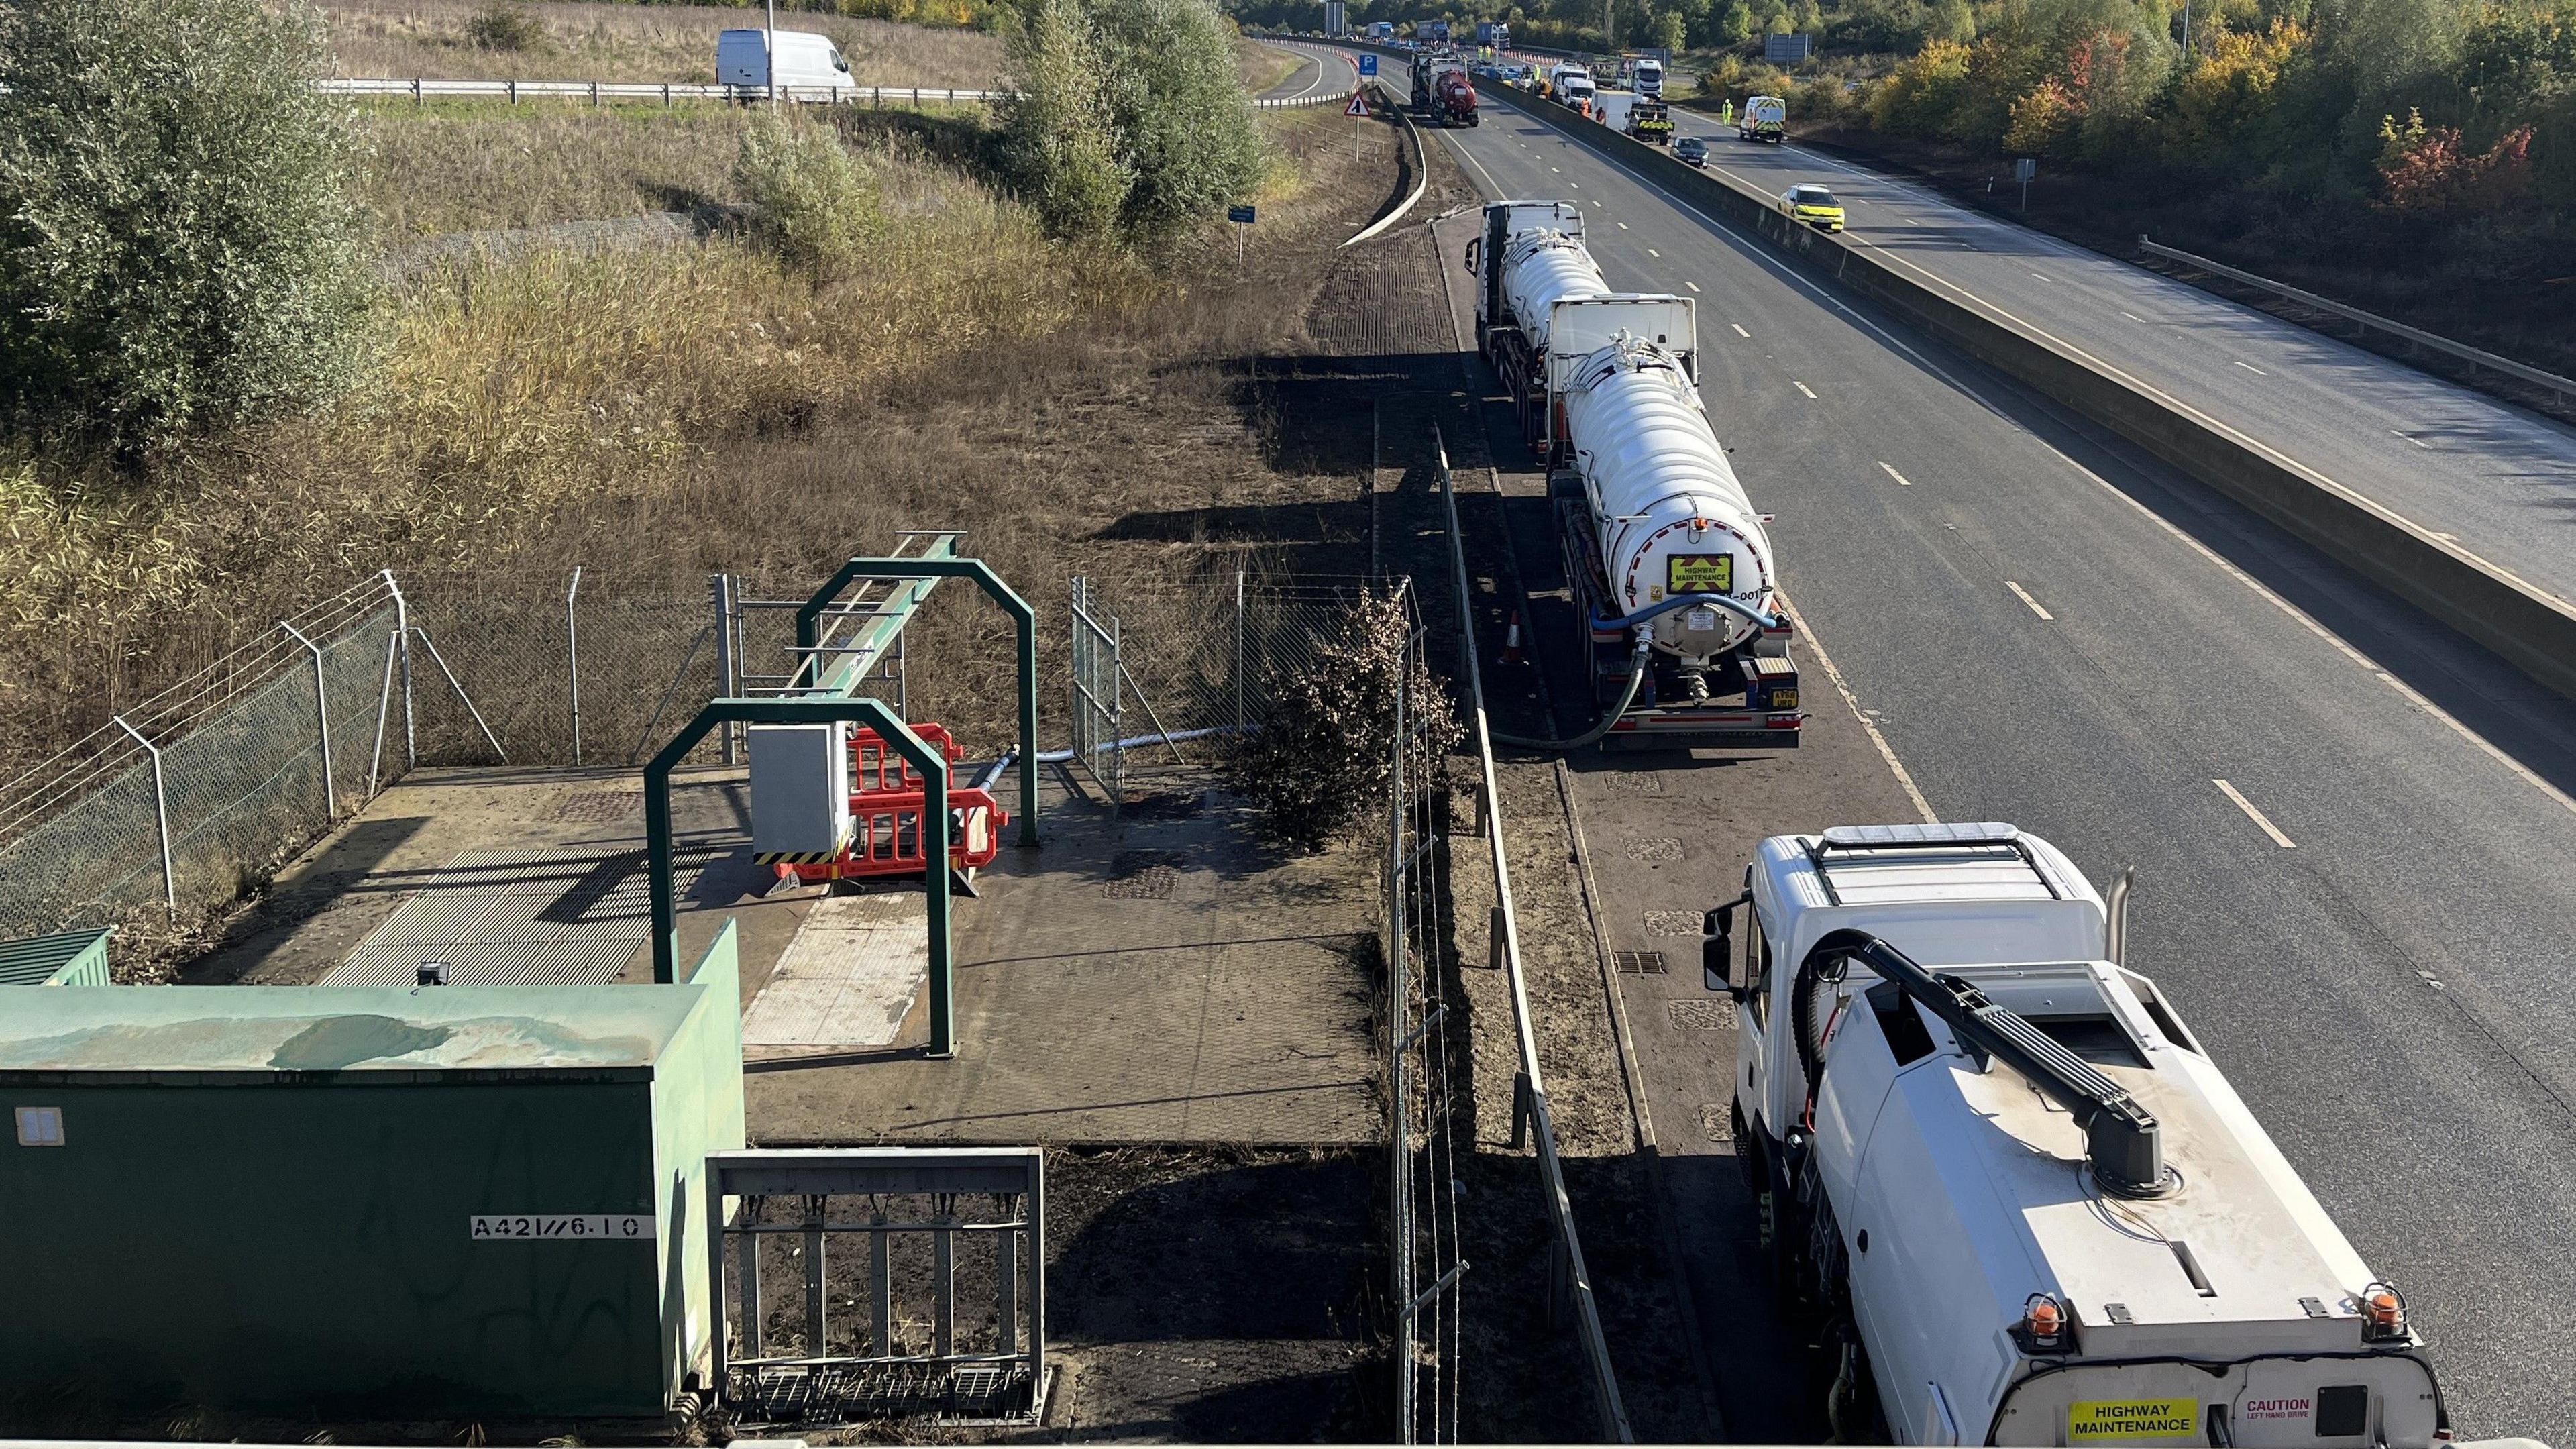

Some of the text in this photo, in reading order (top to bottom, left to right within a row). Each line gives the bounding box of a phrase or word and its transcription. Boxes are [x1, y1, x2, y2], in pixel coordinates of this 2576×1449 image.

[1364, 56, 1373, 66] P
[2096, 1405, 2170, 1417] HIGHWAY
[2247, 1399, 2309, 1411] CAUTION
[2075, 1419, 2190, 1434] MAINTENANCE
